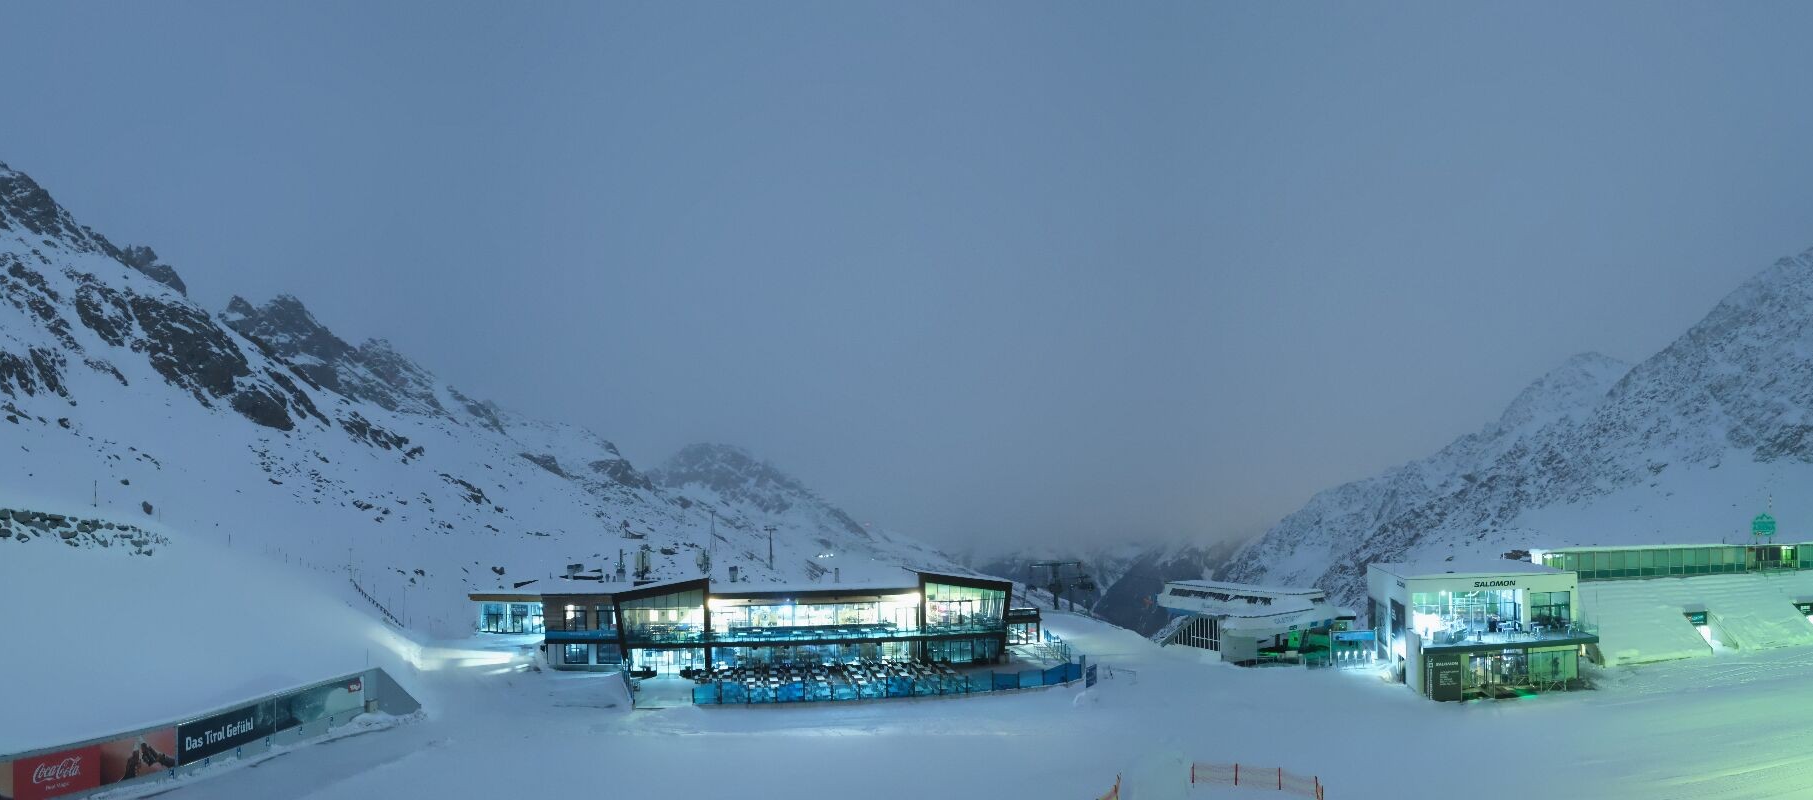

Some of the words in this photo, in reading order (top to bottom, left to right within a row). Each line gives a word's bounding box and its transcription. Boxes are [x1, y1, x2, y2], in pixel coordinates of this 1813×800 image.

[1474, 580, 1516, 588] SALOMON
[185, 736, 204, 751] Das
[205, 726, 225, 744] Tirol
[226, 717, 254, 738] Gefühl
